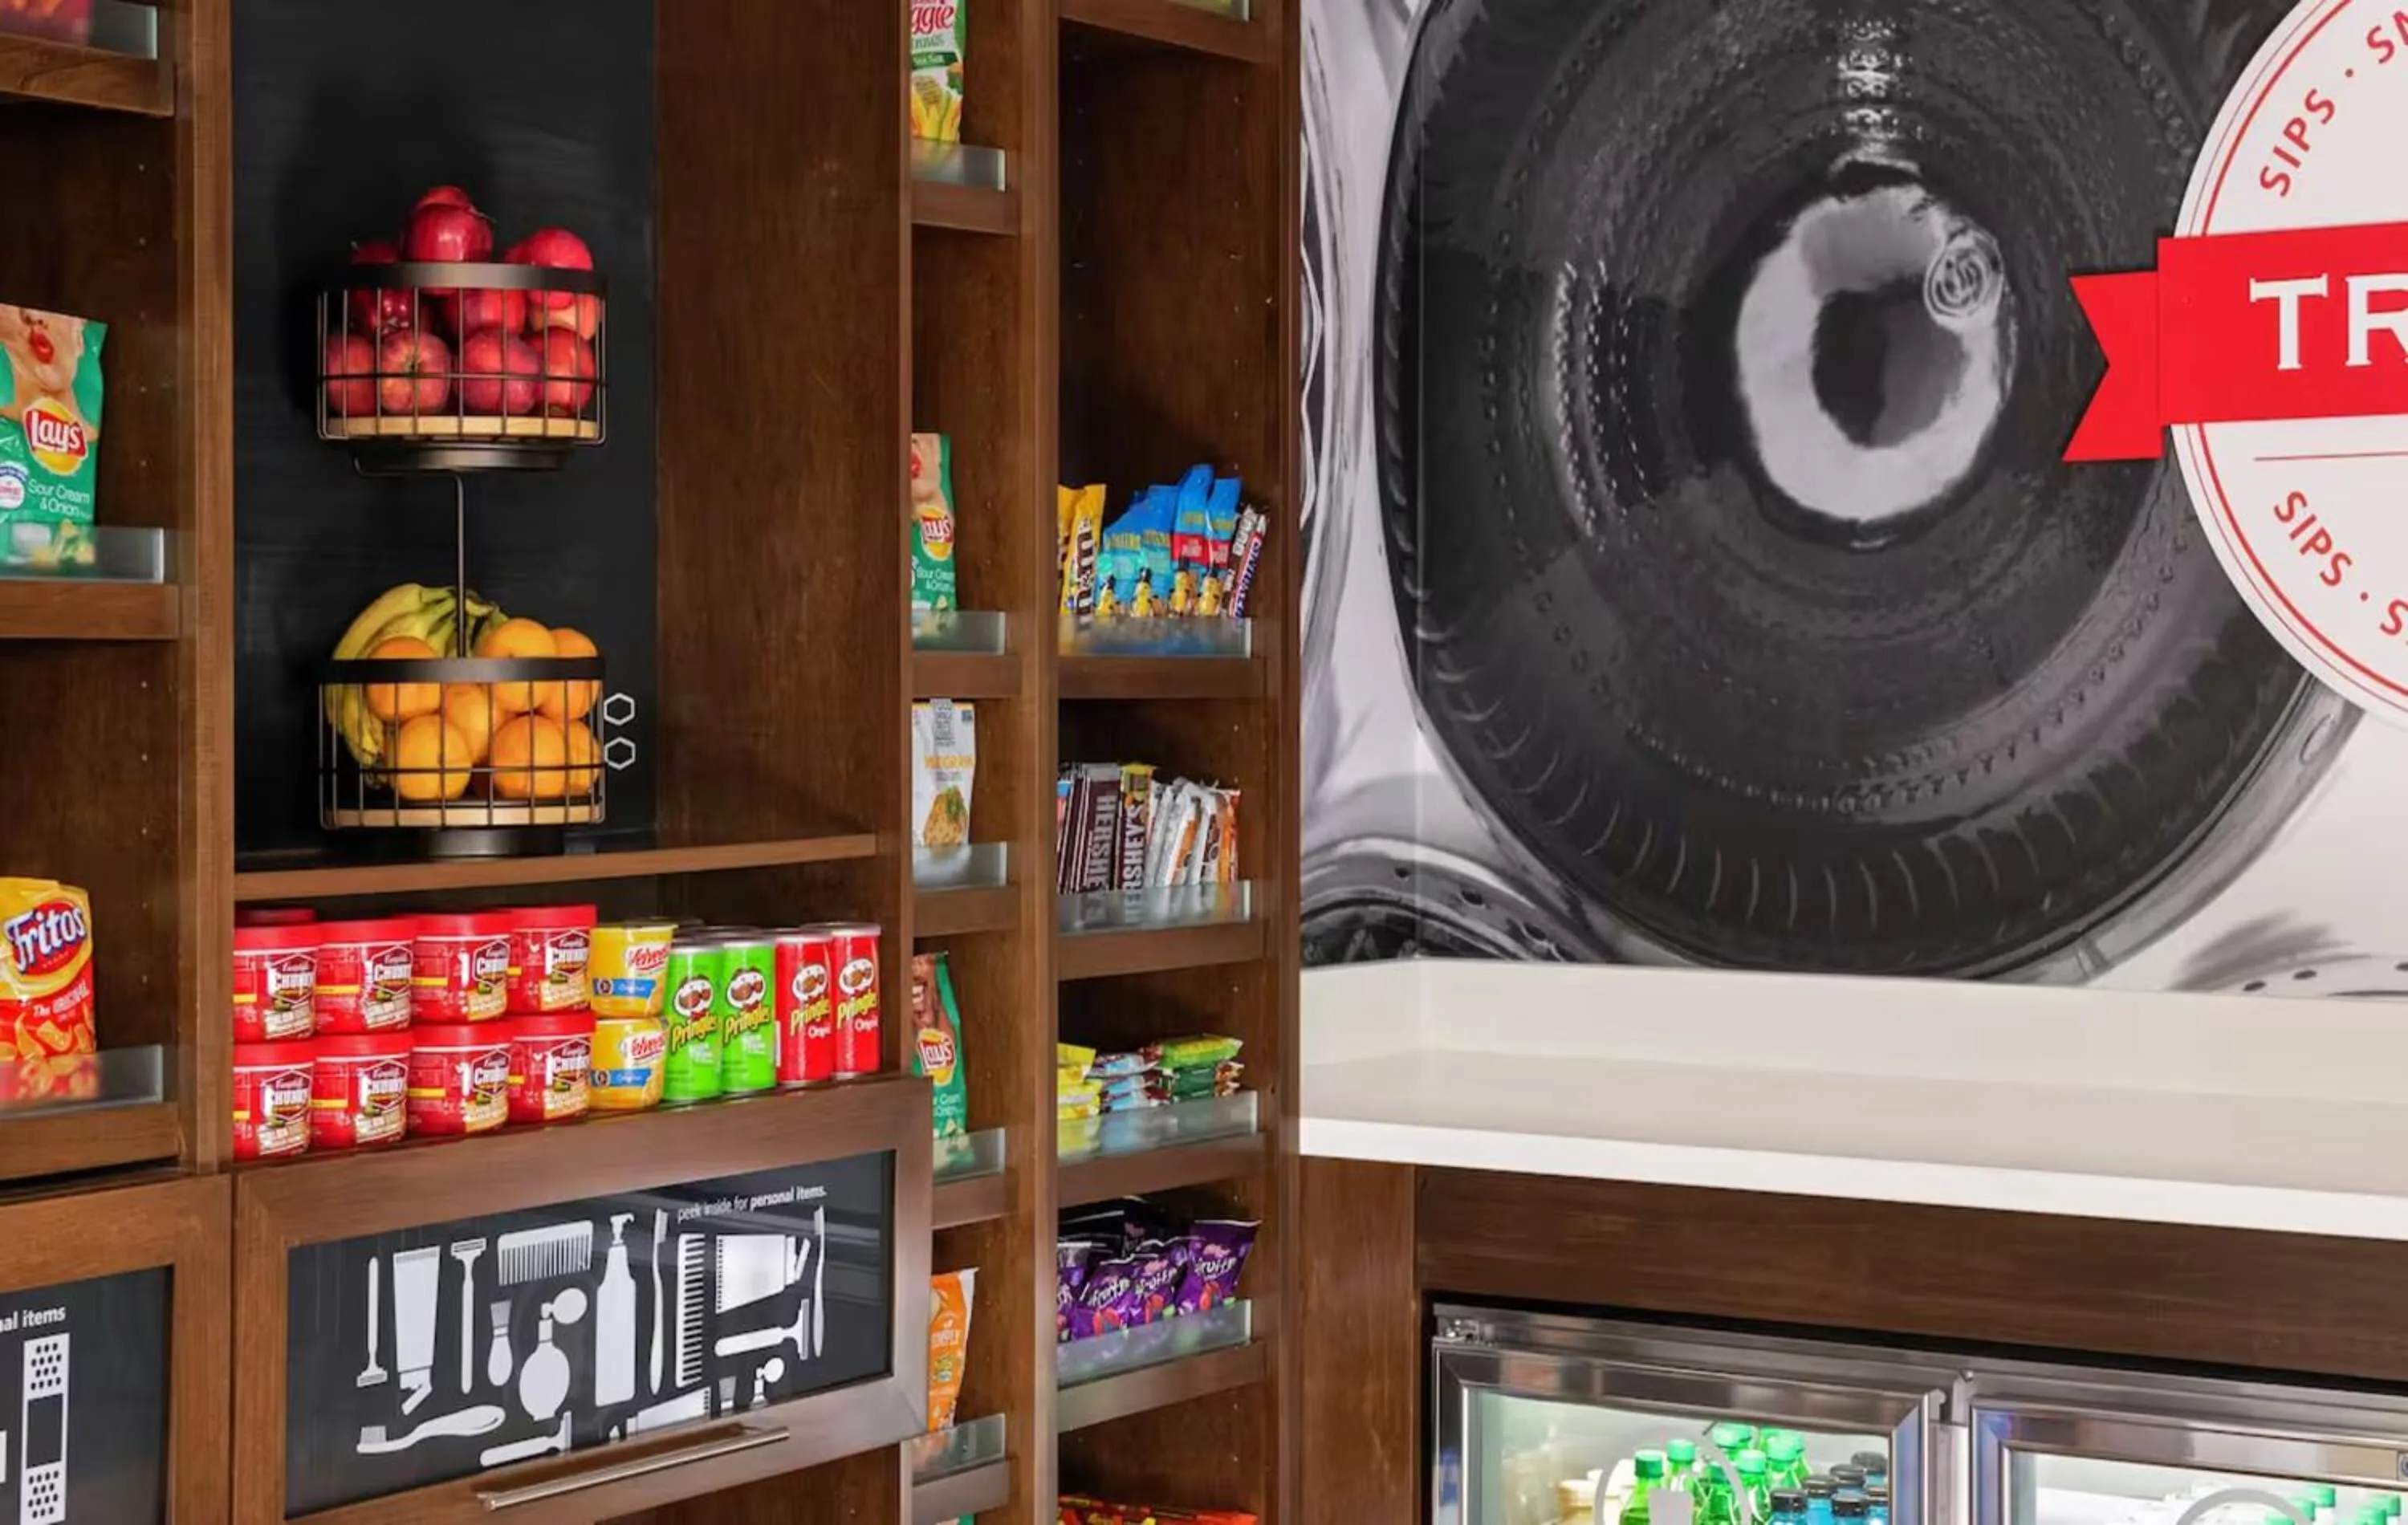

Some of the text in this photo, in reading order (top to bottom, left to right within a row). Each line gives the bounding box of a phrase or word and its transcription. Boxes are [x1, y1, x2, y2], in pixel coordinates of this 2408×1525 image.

[2260, 88, 2337, 197] SIPS
[28, 478, 55, 497] Sour
[56, 484, 90, 504] Cream
[2273, 490, 2353, 587] SIPS
[5, 907, 87, 973] Fritos
[677, 1202, 702, 1224] peek
[704, 1198, 732, 1216] inside
[734, 1194, 749, 1212] for
[750, 1185, 795, 1212] personal
[22, 1307, 67, 1328] items
